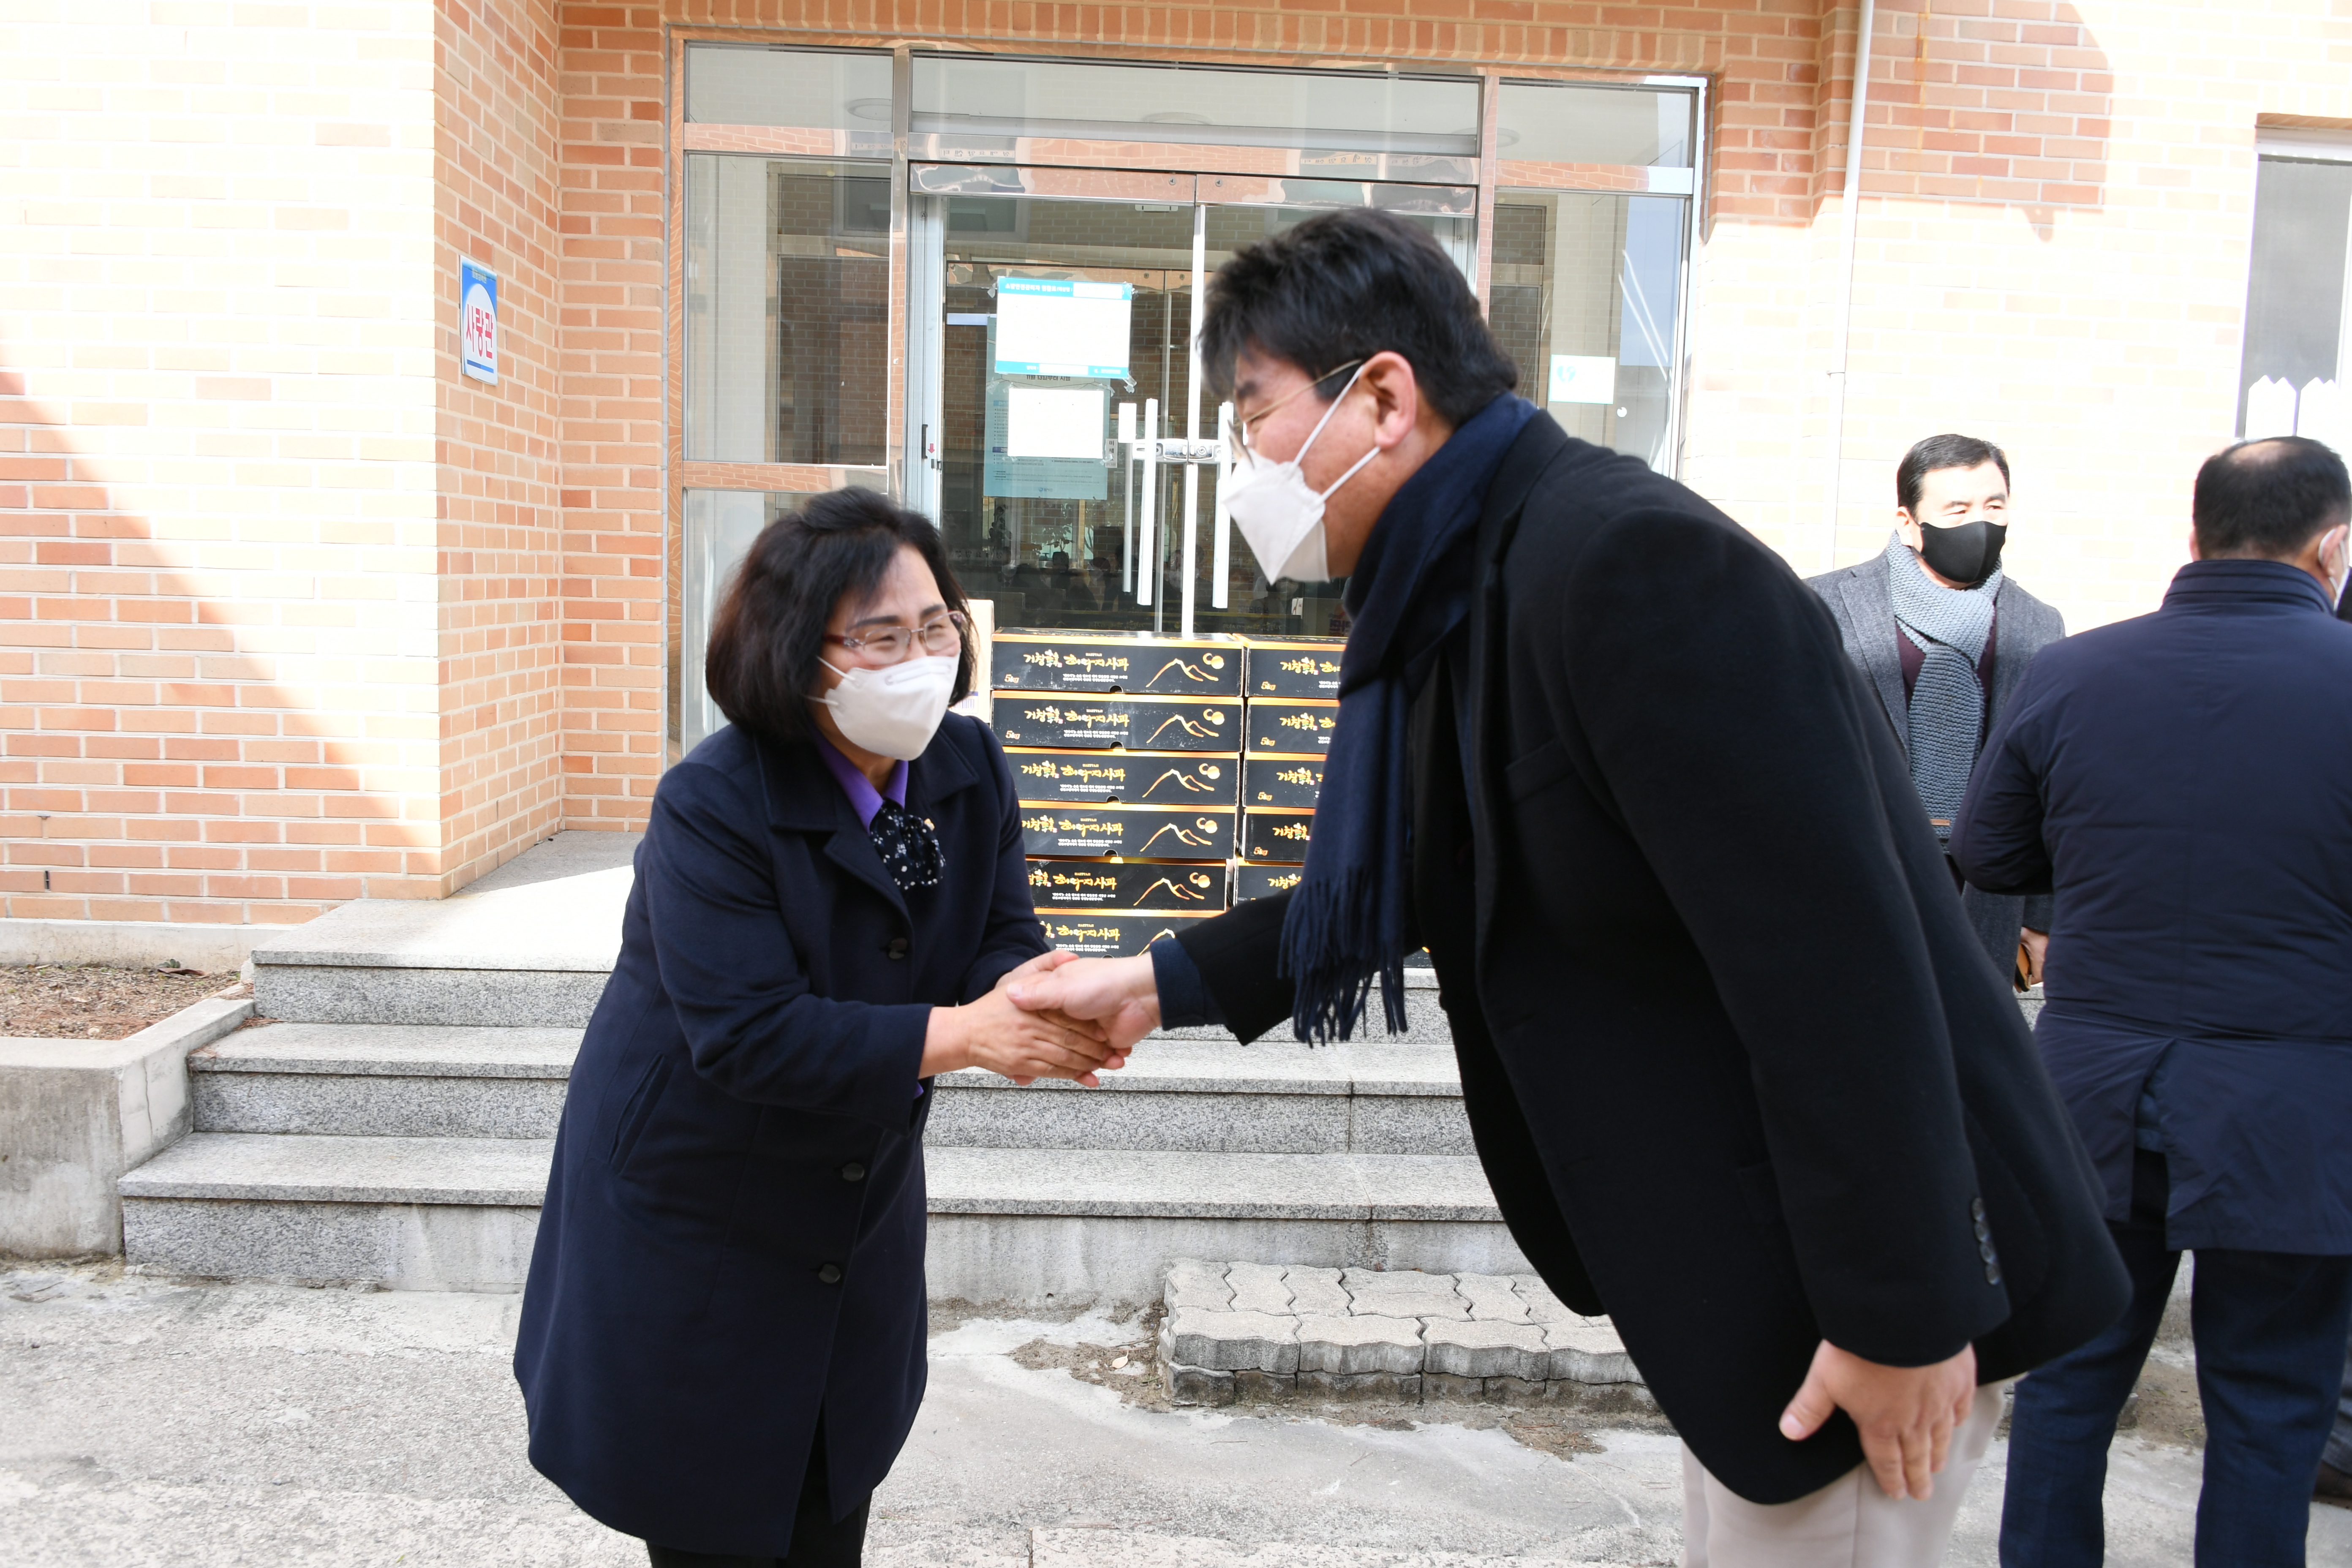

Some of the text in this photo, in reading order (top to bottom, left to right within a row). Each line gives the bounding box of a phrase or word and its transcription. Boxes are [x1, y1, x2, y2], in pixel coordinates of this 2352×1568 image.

[466, 304, 494, 359] 사랑관
[1004, 674, 1019, 683] 5kg
[1261, 681, 1276, 691] 5kg
[1005, 730, 1021, 740] 5kg
[1260, 737, 1275, 746] 5kg
[1258, 791, 1273, 801] 5kg
[1253, 846, 1269, 856] 5kg
